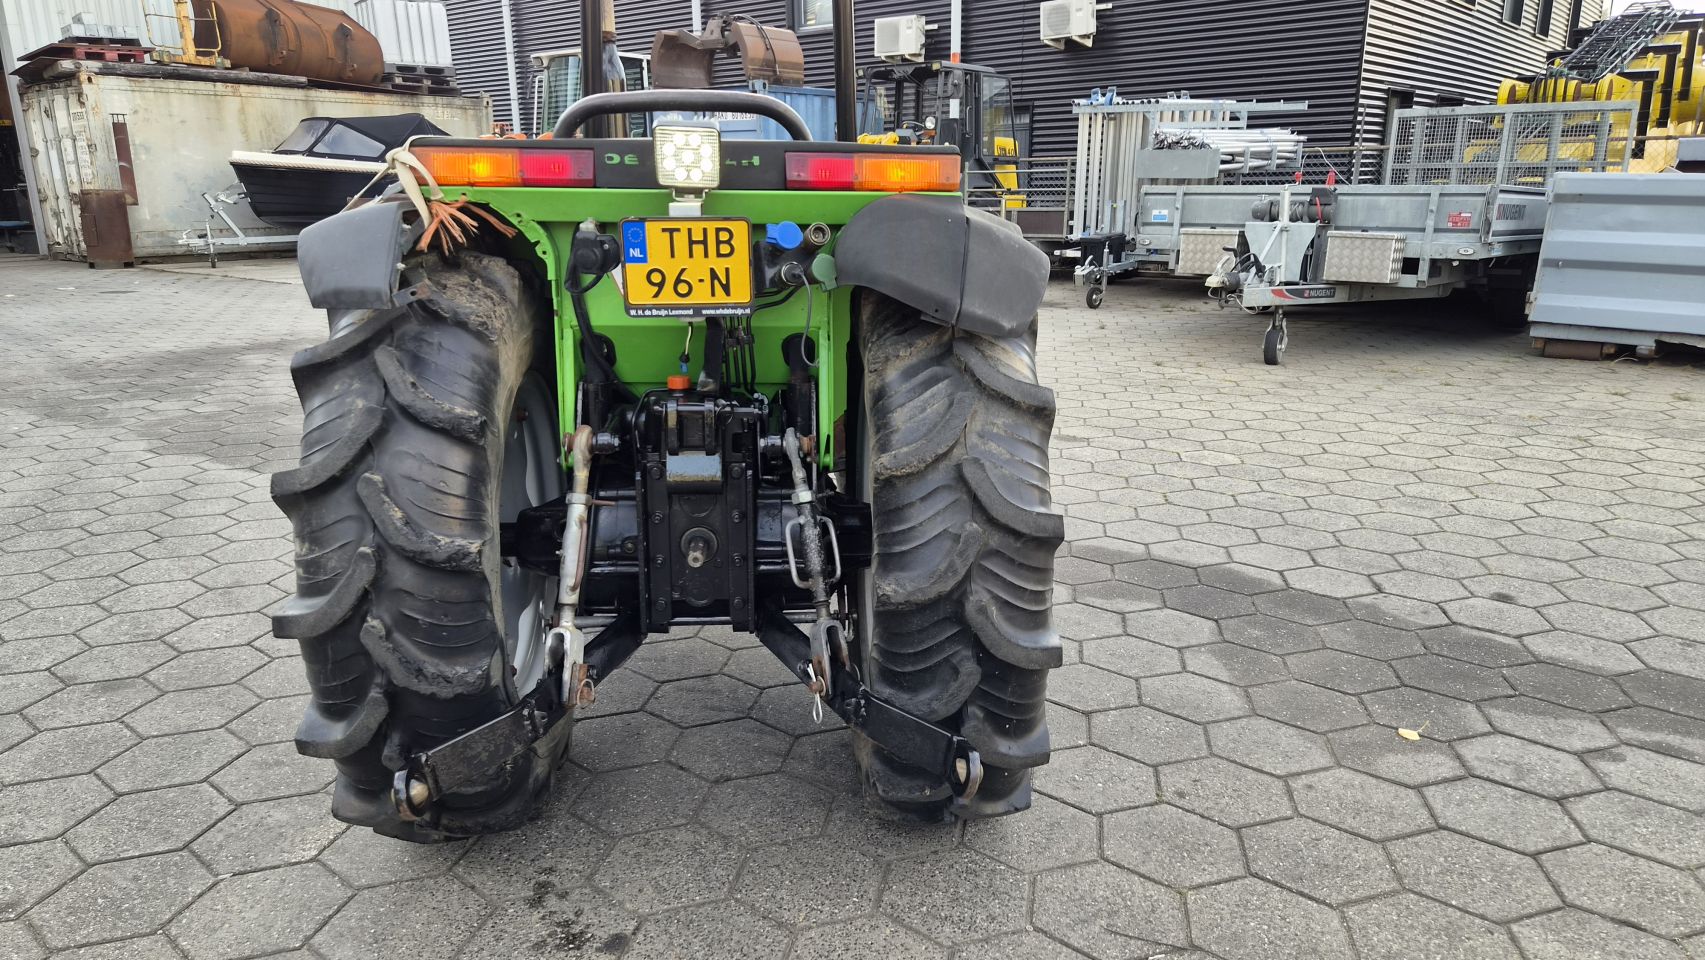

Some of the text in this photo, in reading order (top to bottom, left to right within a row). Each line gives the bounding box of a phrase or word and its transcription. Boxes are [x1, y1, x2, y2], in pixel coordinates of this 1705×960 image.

[1503, 203, 1527, 221] NUGENT
[661, 226, 736, 259] THB
[629, 247, 644, 258] NL
[645, 266, 732, 299] 96-N
[1309, 288, 1335, 297] NUGENT
[652, 309, 668, 317] Bruijn
